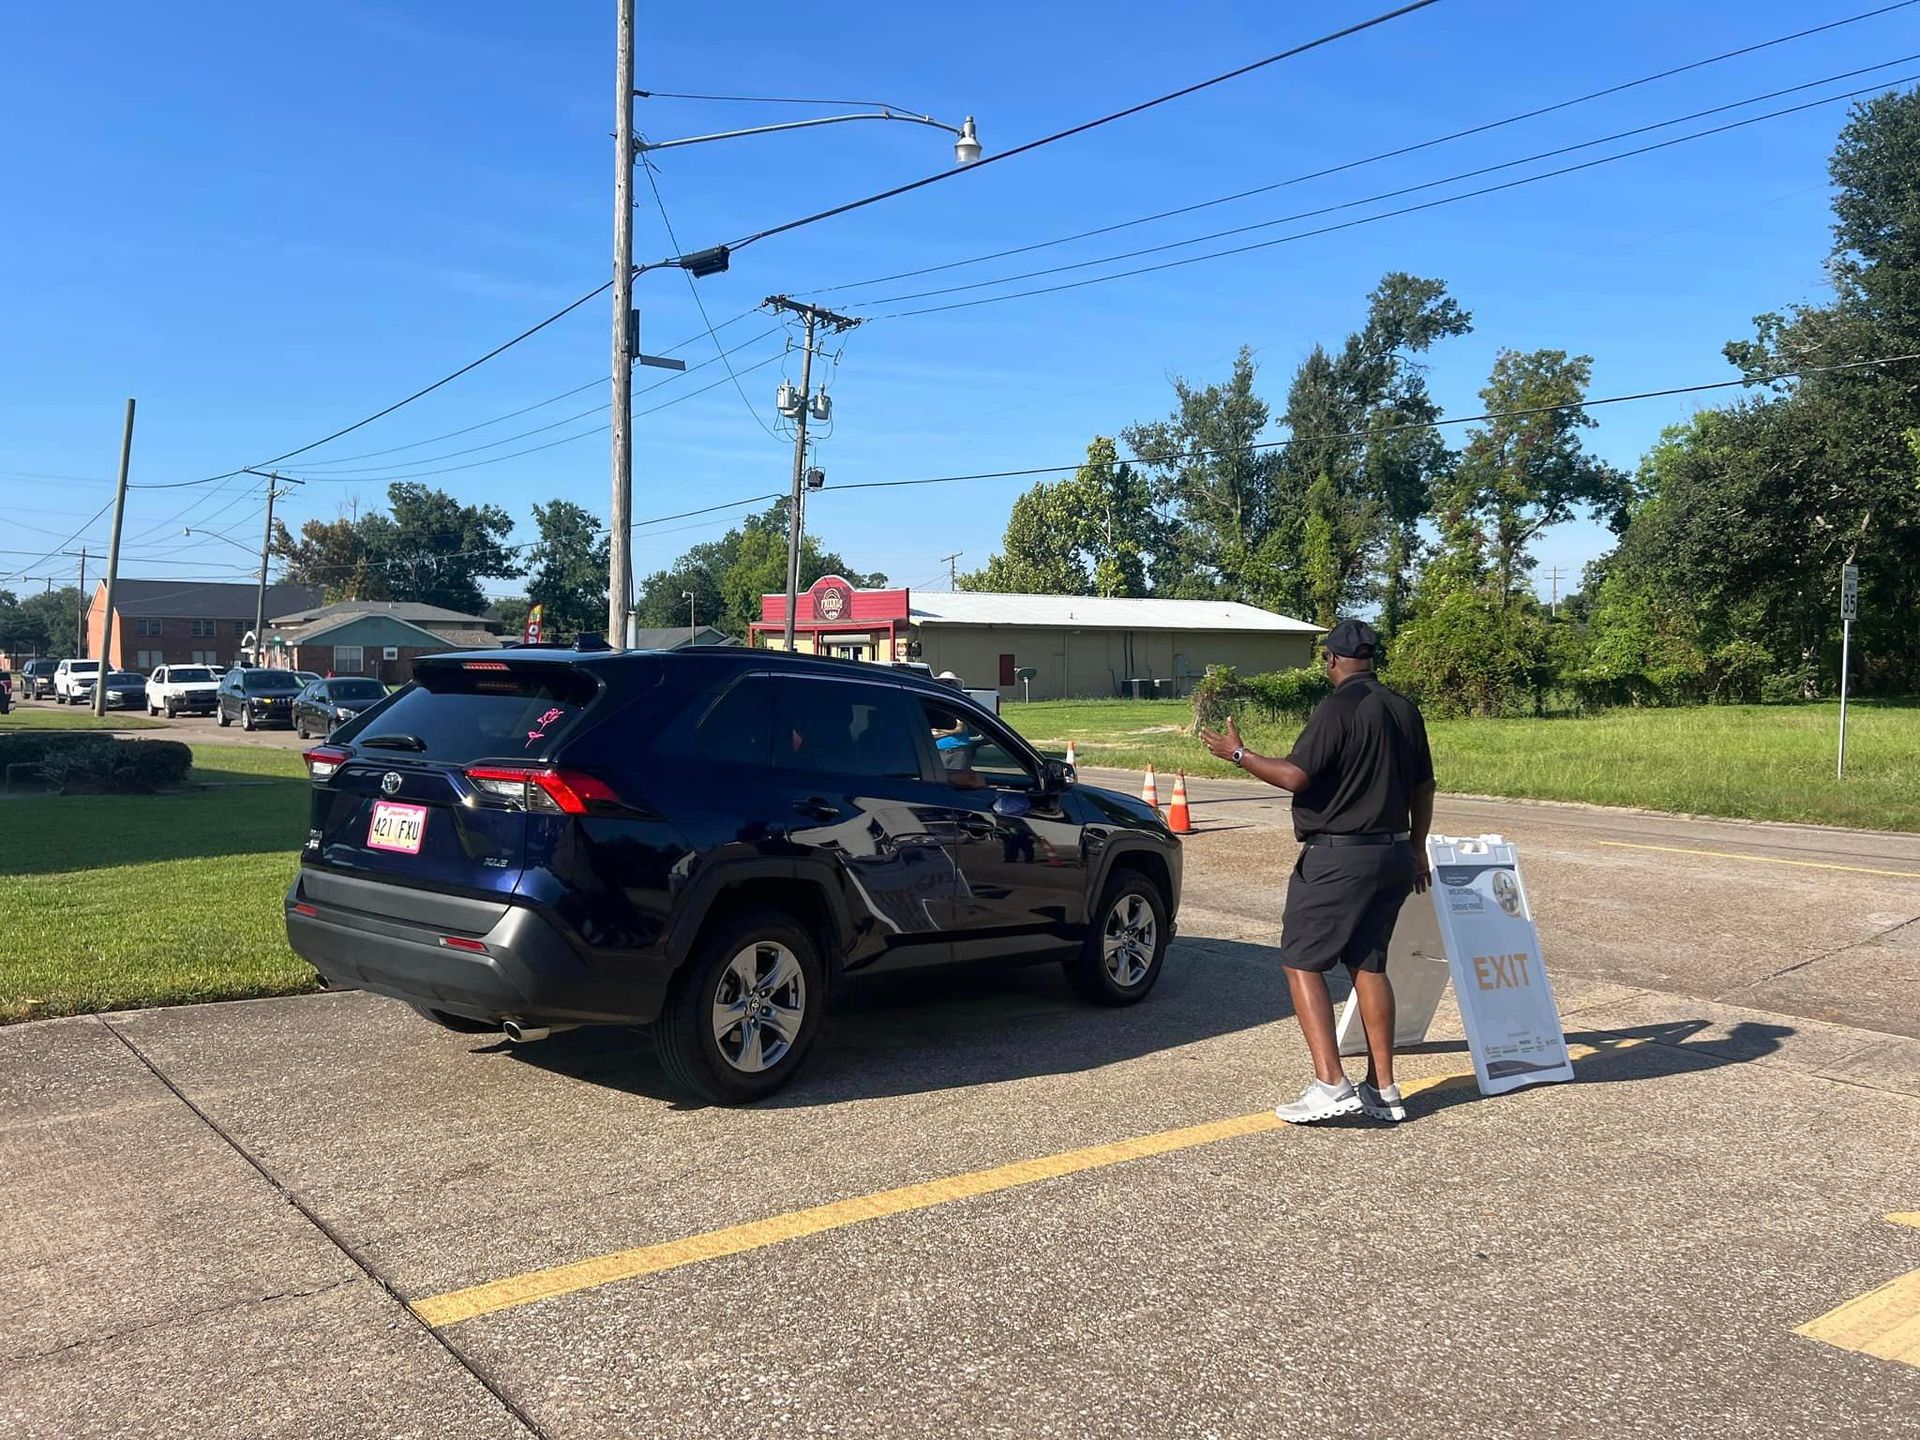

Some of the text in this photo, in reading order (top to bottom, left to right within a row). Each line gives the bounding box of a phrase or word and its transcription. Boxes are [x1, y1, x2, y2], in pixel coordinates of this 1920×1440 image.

[1843, 594, 1855, 613] 35
[374, 817, 420, 840] 421 FXU
[483, 857, 509, 868] XLE
[1473, 954, 1530, 990] EXIT
